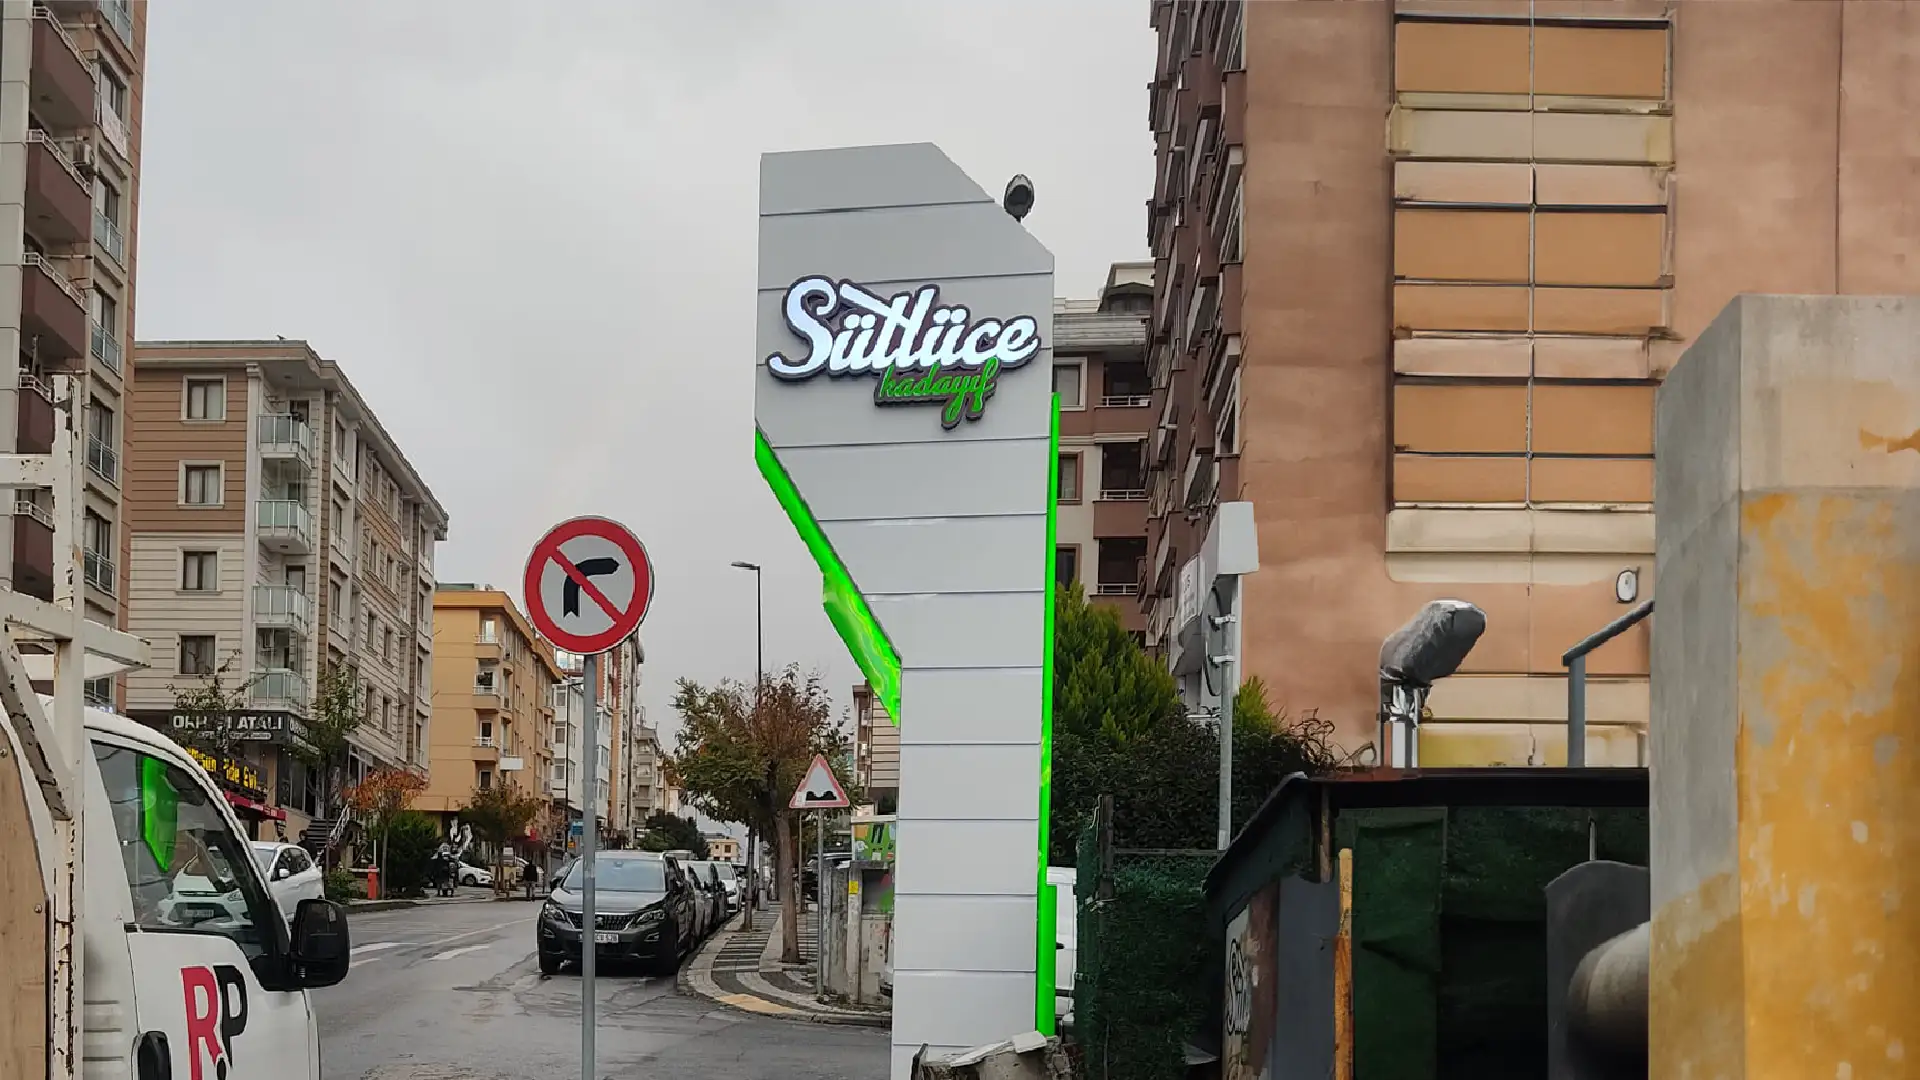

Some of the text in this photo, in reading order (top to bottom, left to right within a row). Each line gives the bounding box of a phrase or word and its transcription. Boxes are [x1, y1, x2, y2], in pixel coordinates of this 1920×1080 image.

[769, 278, 1039, 375] Sütlüce
[172, 715, 233, 730] ORH
[236, 716, 282, 730] ATALI
